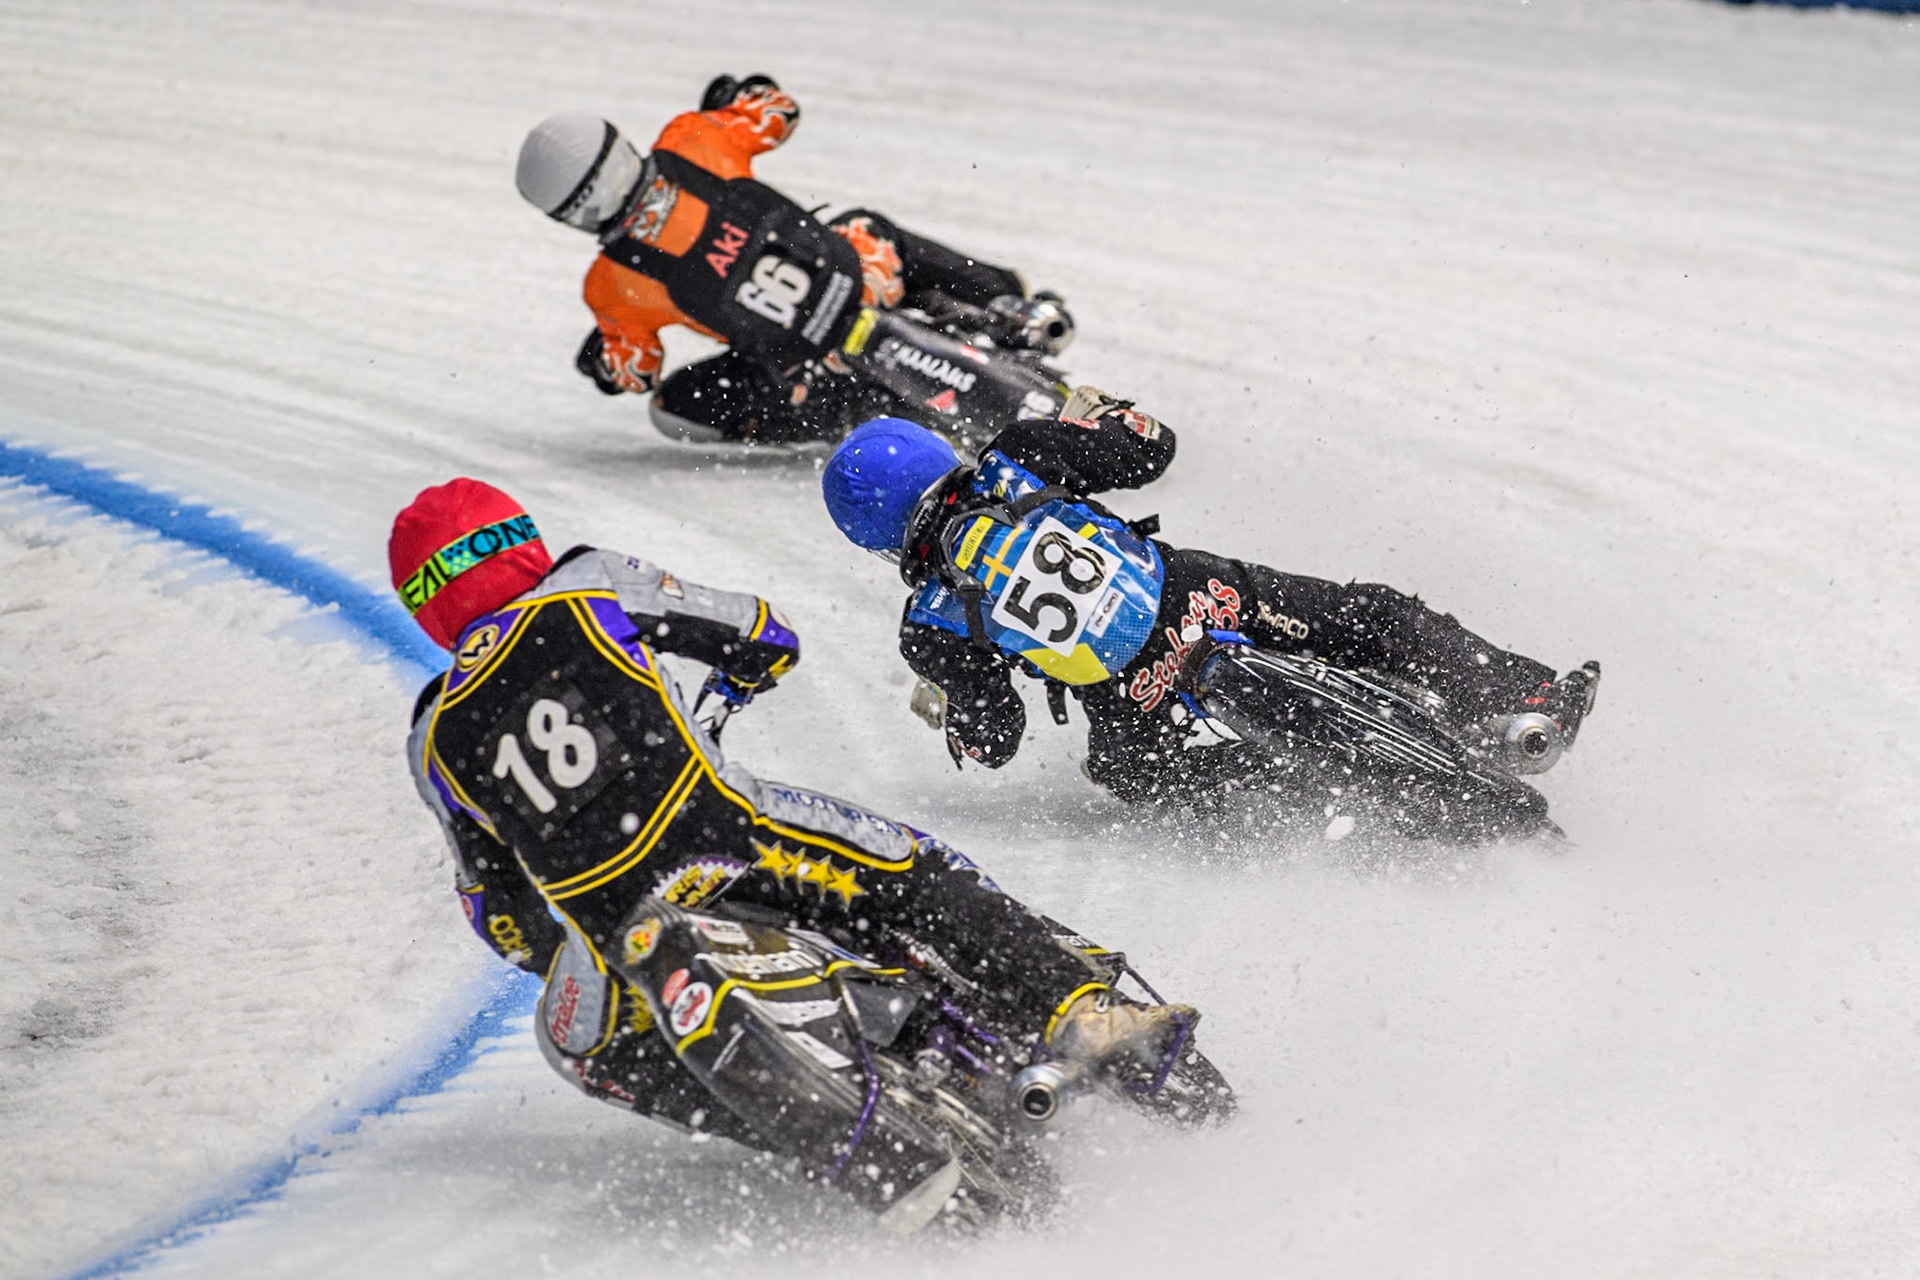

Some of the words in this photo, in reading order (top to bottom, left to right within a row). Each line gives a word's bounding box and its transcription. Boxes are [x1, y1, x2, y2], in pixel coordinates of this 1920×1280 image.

[705, 222, 749, 278] Aki
[735, 255, 811, 329] 66
[1003, 531, 1106, 643] 58
[1207, 578, 1241, 631] 58
[492, 699, 598, 813] 18
